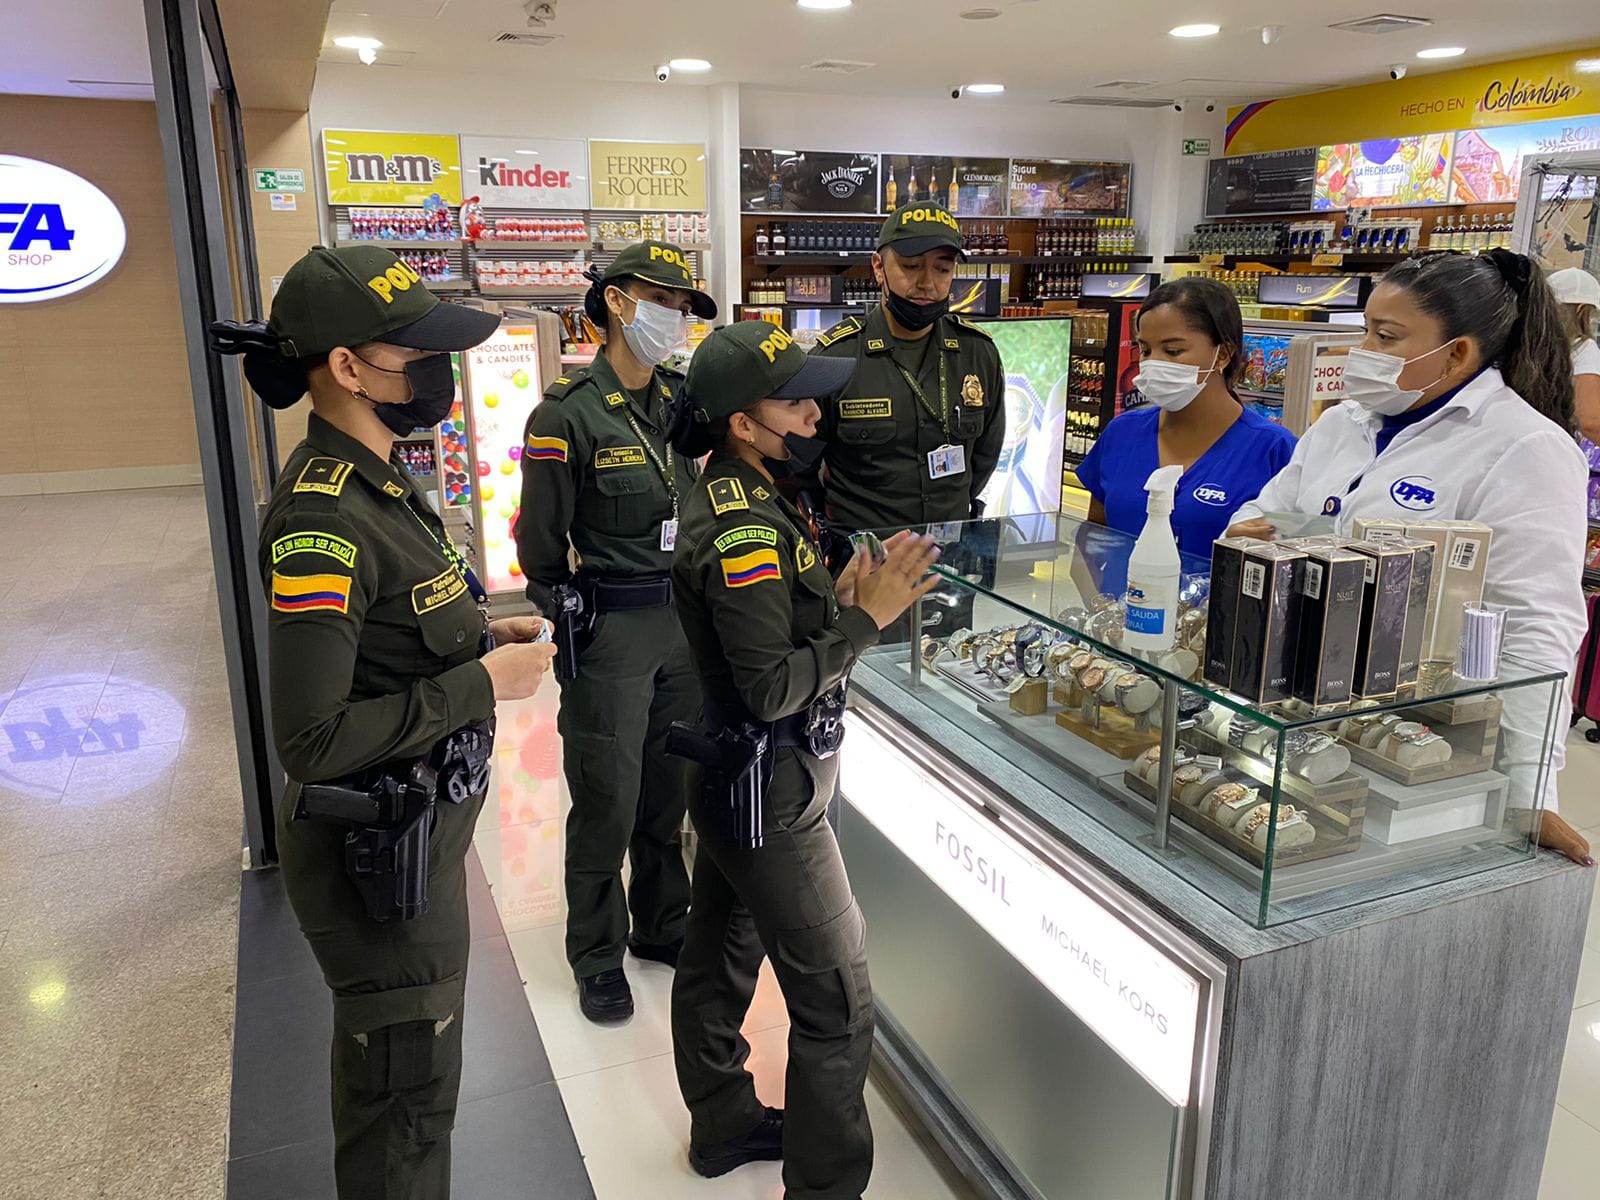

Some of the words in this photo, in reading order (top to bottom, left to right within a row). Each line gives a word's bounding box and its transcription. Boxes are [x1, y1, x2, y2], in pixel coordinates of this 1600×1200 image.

[1400, 101, 1443, 117] HECHO
[1447, 98, 1466, 111] EN
[1483, 76, 1572, 112] Colombia
[607, 156, 687, 176] FERRERO
[1012, 165, 1037, 174] SIGUE
[1012, 174, 1023, 182] TU
[607, 177, 688, 197] ROCHER
[8, 254, 53, 266] SHOP
[1198, 487, 1226, 502] DFA
[1395, 480, 1437, 505] DFA
[276, 544, 285, 556] ES
[1130, 609, 1160, 620] SALIDA
[935, 820, 1011, 907] FOSSIL
[1041, 915, 1111, 988] MICHAEL
[1118, 980, 1168, 1035] KORS
